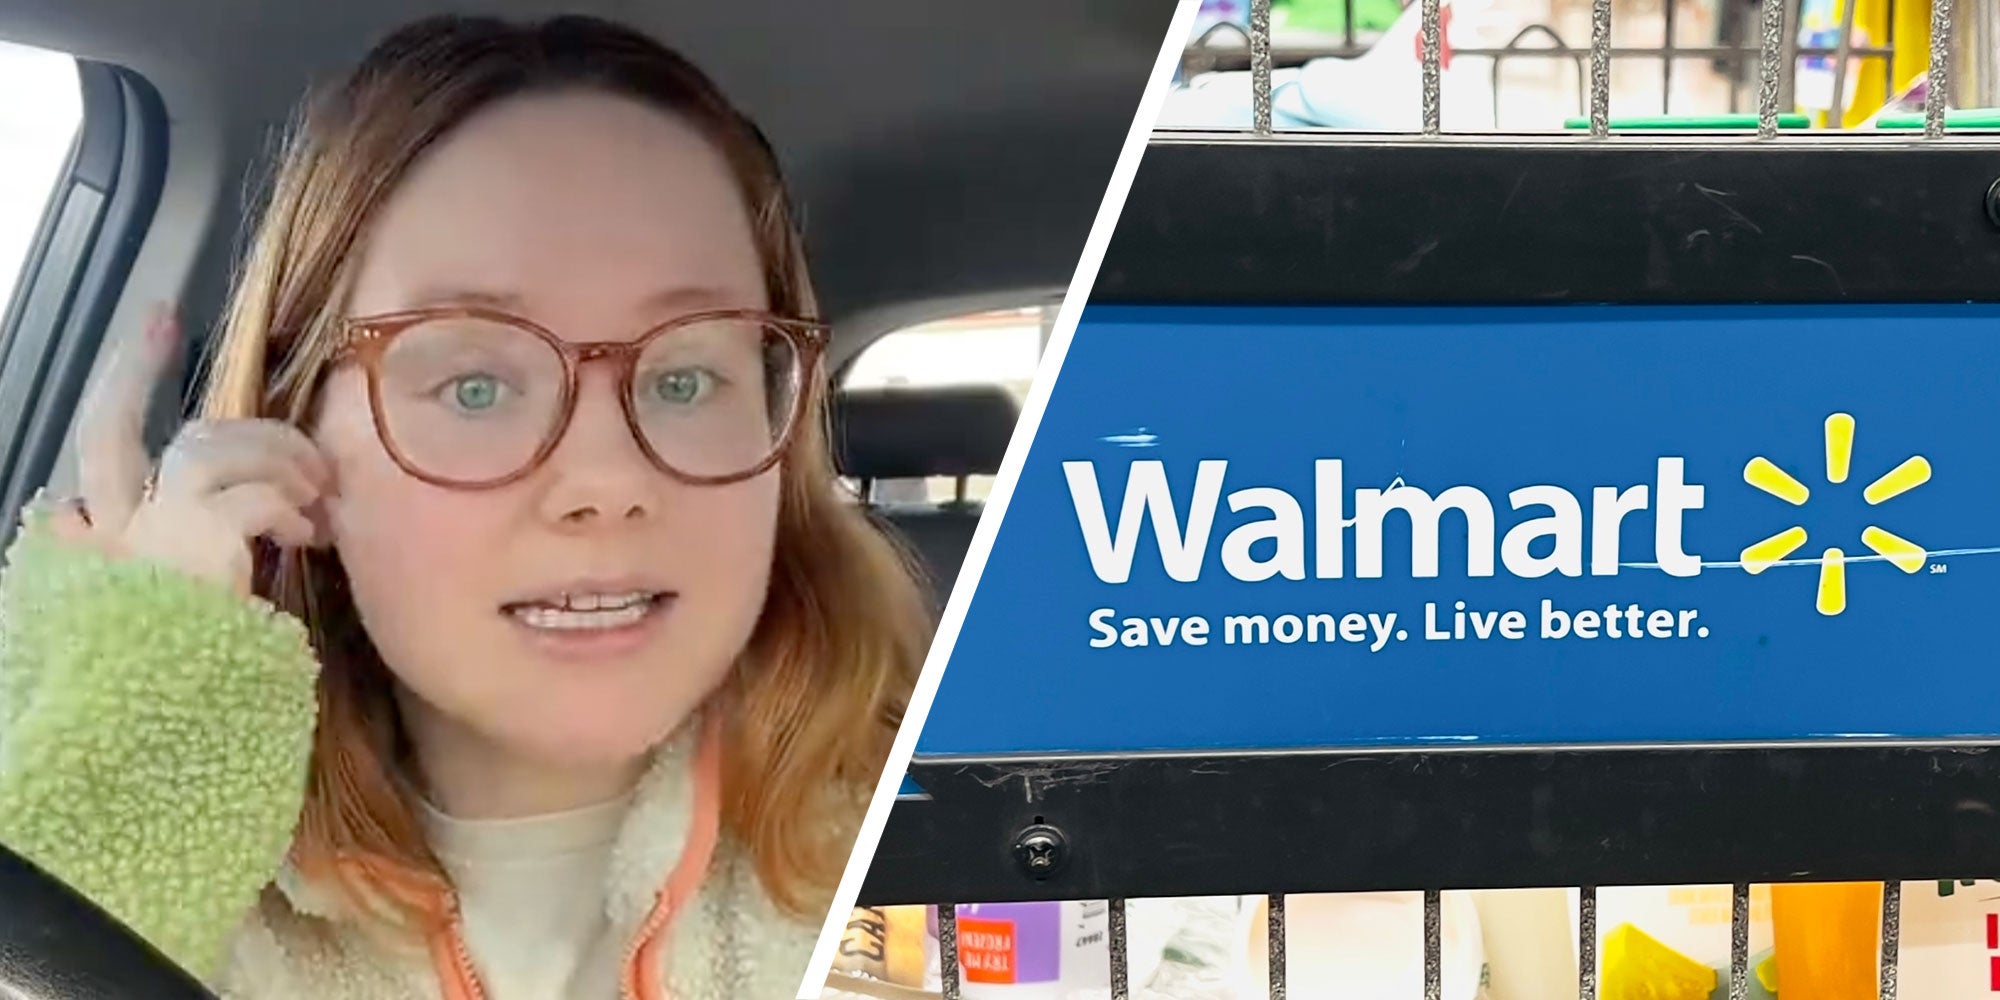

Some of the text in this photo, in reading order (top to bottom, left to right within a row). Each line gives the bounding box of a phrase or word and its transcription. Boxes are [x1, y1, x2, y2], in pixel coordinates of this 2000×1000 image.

[1062, 456, 1706, 584] Walmart
[1929, 563, 1948, 574] SM
[1088, 599, 1709, 652] Save money. Live better.
